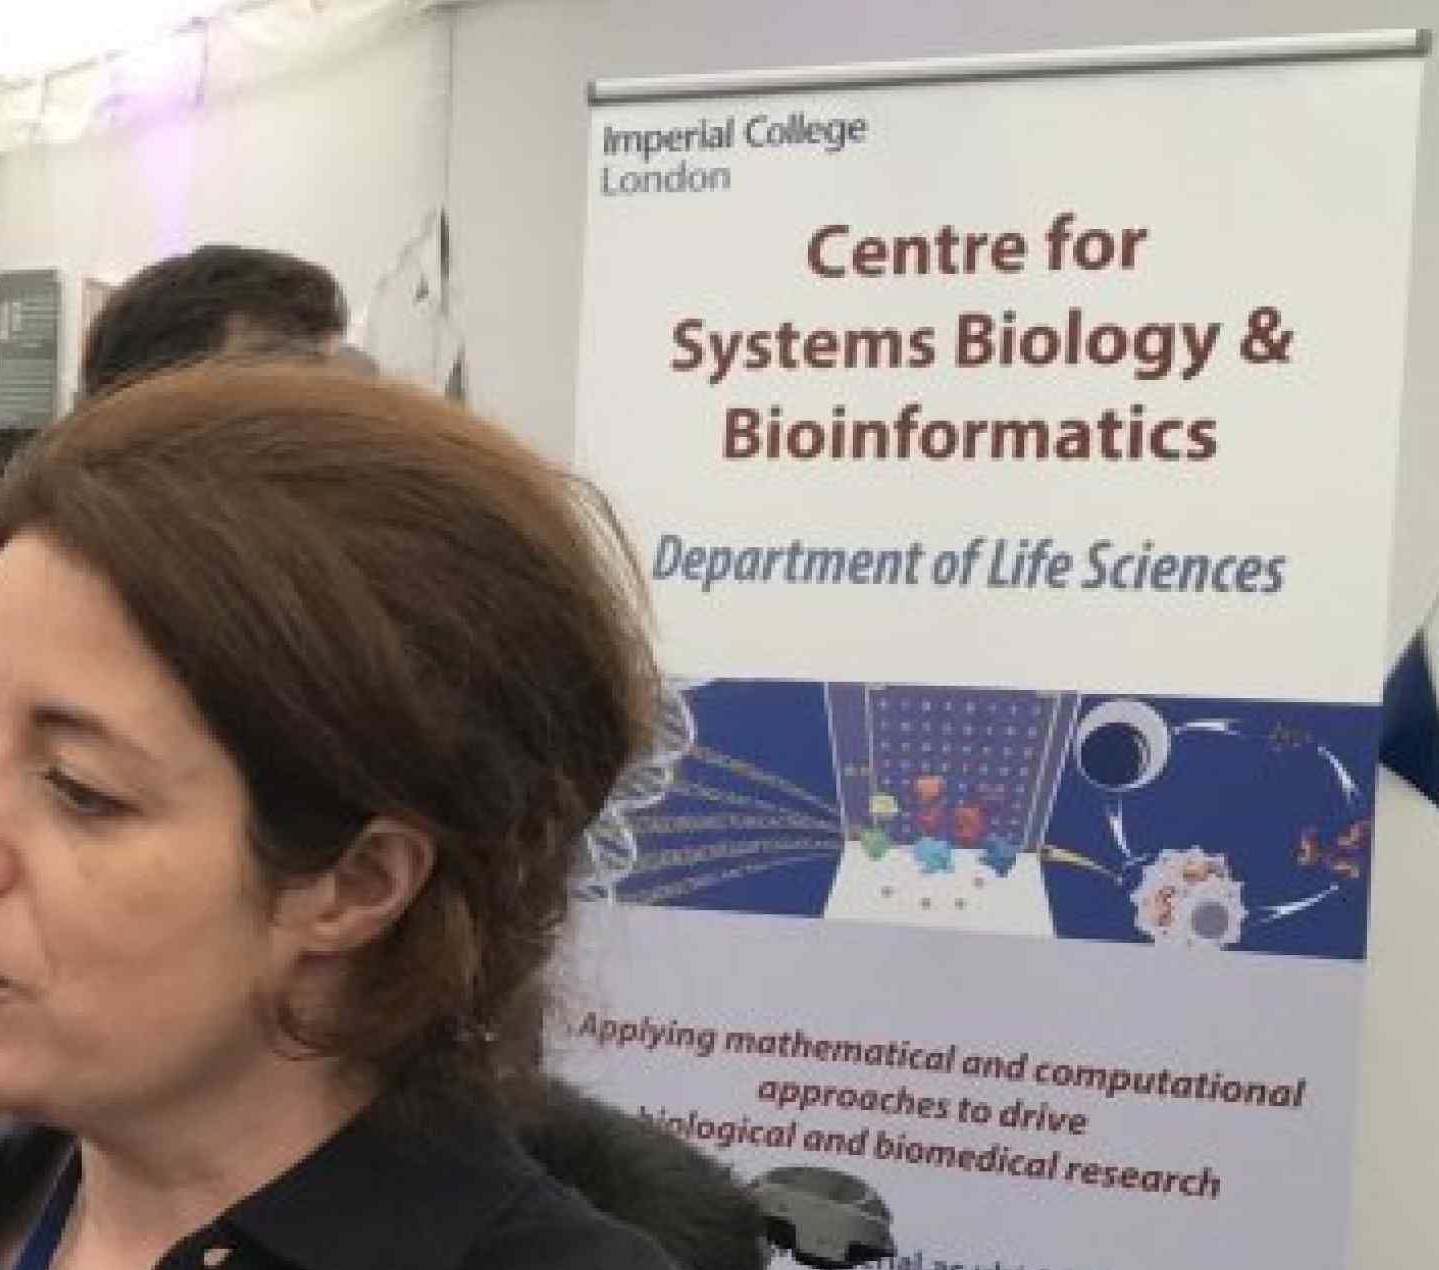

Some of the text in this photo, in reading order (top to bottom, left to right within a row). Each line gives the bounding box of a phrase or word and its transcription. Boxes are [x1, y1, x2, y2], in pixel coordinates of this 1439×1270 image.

[601, 111, 868, 163] Imperial College
[601, 159, 731, 195] London
[807, 212, 1148, 278] Centre for
[670, 305, 1295, 384] Systems Biology &
[723, 403, 1219, 461] Bioinformatics
[652, 533, 1288, 594] Department of Life Sciences
[579, 1011, 1307, 1108] Applying mathematical and computational
[758, 1079, 1089, 1137] approaches to drive
[802, 1127, 870, 1157] and
[873, 1129, 1061, 1180] biomedical
[1064, 1158, 1222, 1201] research
